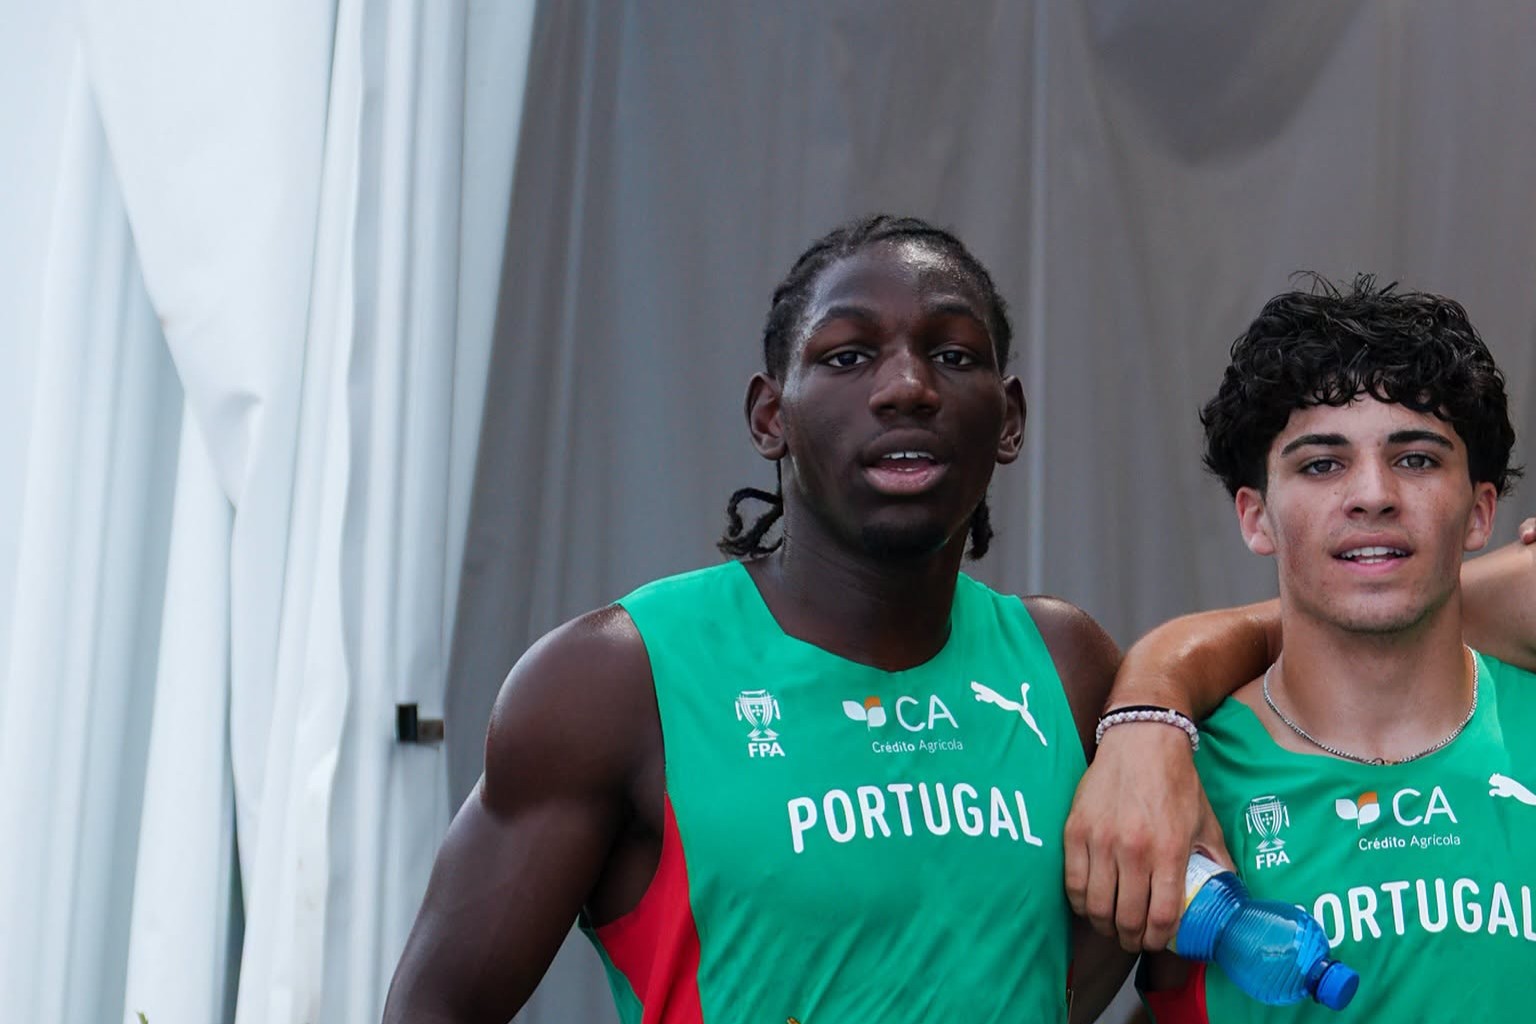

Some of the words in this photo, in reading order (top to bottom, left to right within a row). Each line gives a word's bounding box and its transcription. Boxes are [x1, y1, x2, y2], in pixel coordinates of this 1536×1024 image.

[895, 694, 959, 732] CA
[748, 742, 785, 757] FPA
[872, 739, 915, 753] Crédito
[919, 738, 963, 753] Agrícola
[1392, 785, 1458, 827] CA
[787, 782, 1043, 853] PORTUGAL
[1359, 837, 1406, 851] Crédito
[1410, 834, 1460, 848] Agrícola
[1256, 852, 1290, 870] FPA
